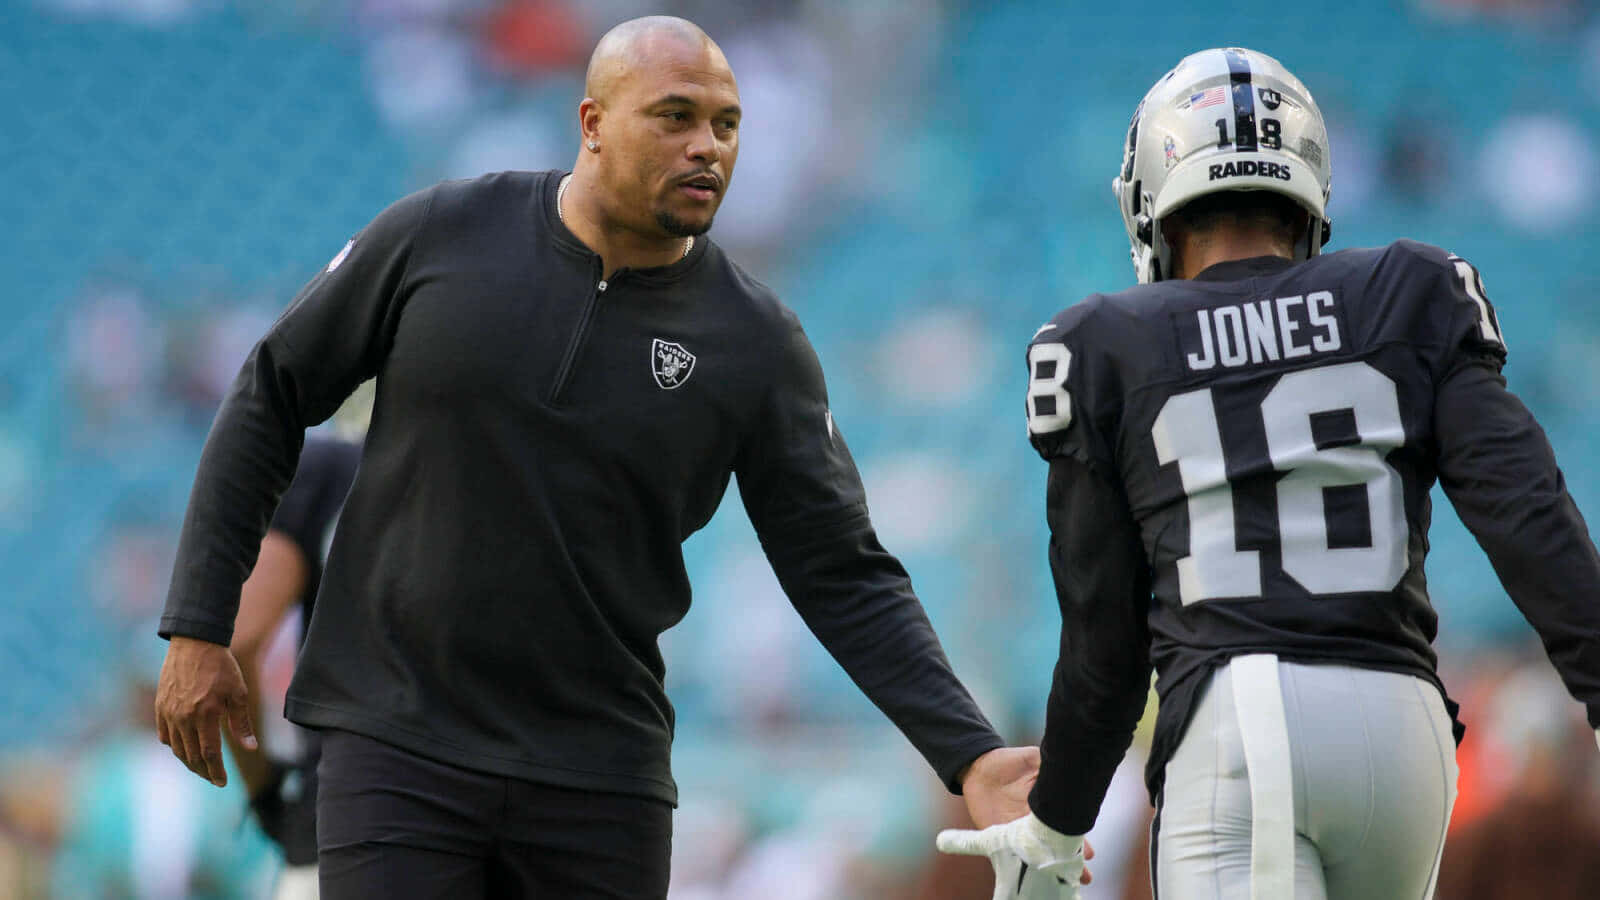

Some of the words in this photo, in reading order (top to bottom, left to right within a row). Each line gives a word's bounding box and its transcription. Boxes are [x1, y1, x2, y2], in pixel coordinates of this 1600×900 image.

[1208, 160, 1292, 182] RAIDERS
[1187, 290, 1341, 371] JONES
[1453, 261, 1507, 352] 1
[1026, 342, 1072, 435] 8
[1151, 360, 1410, 607] 18
